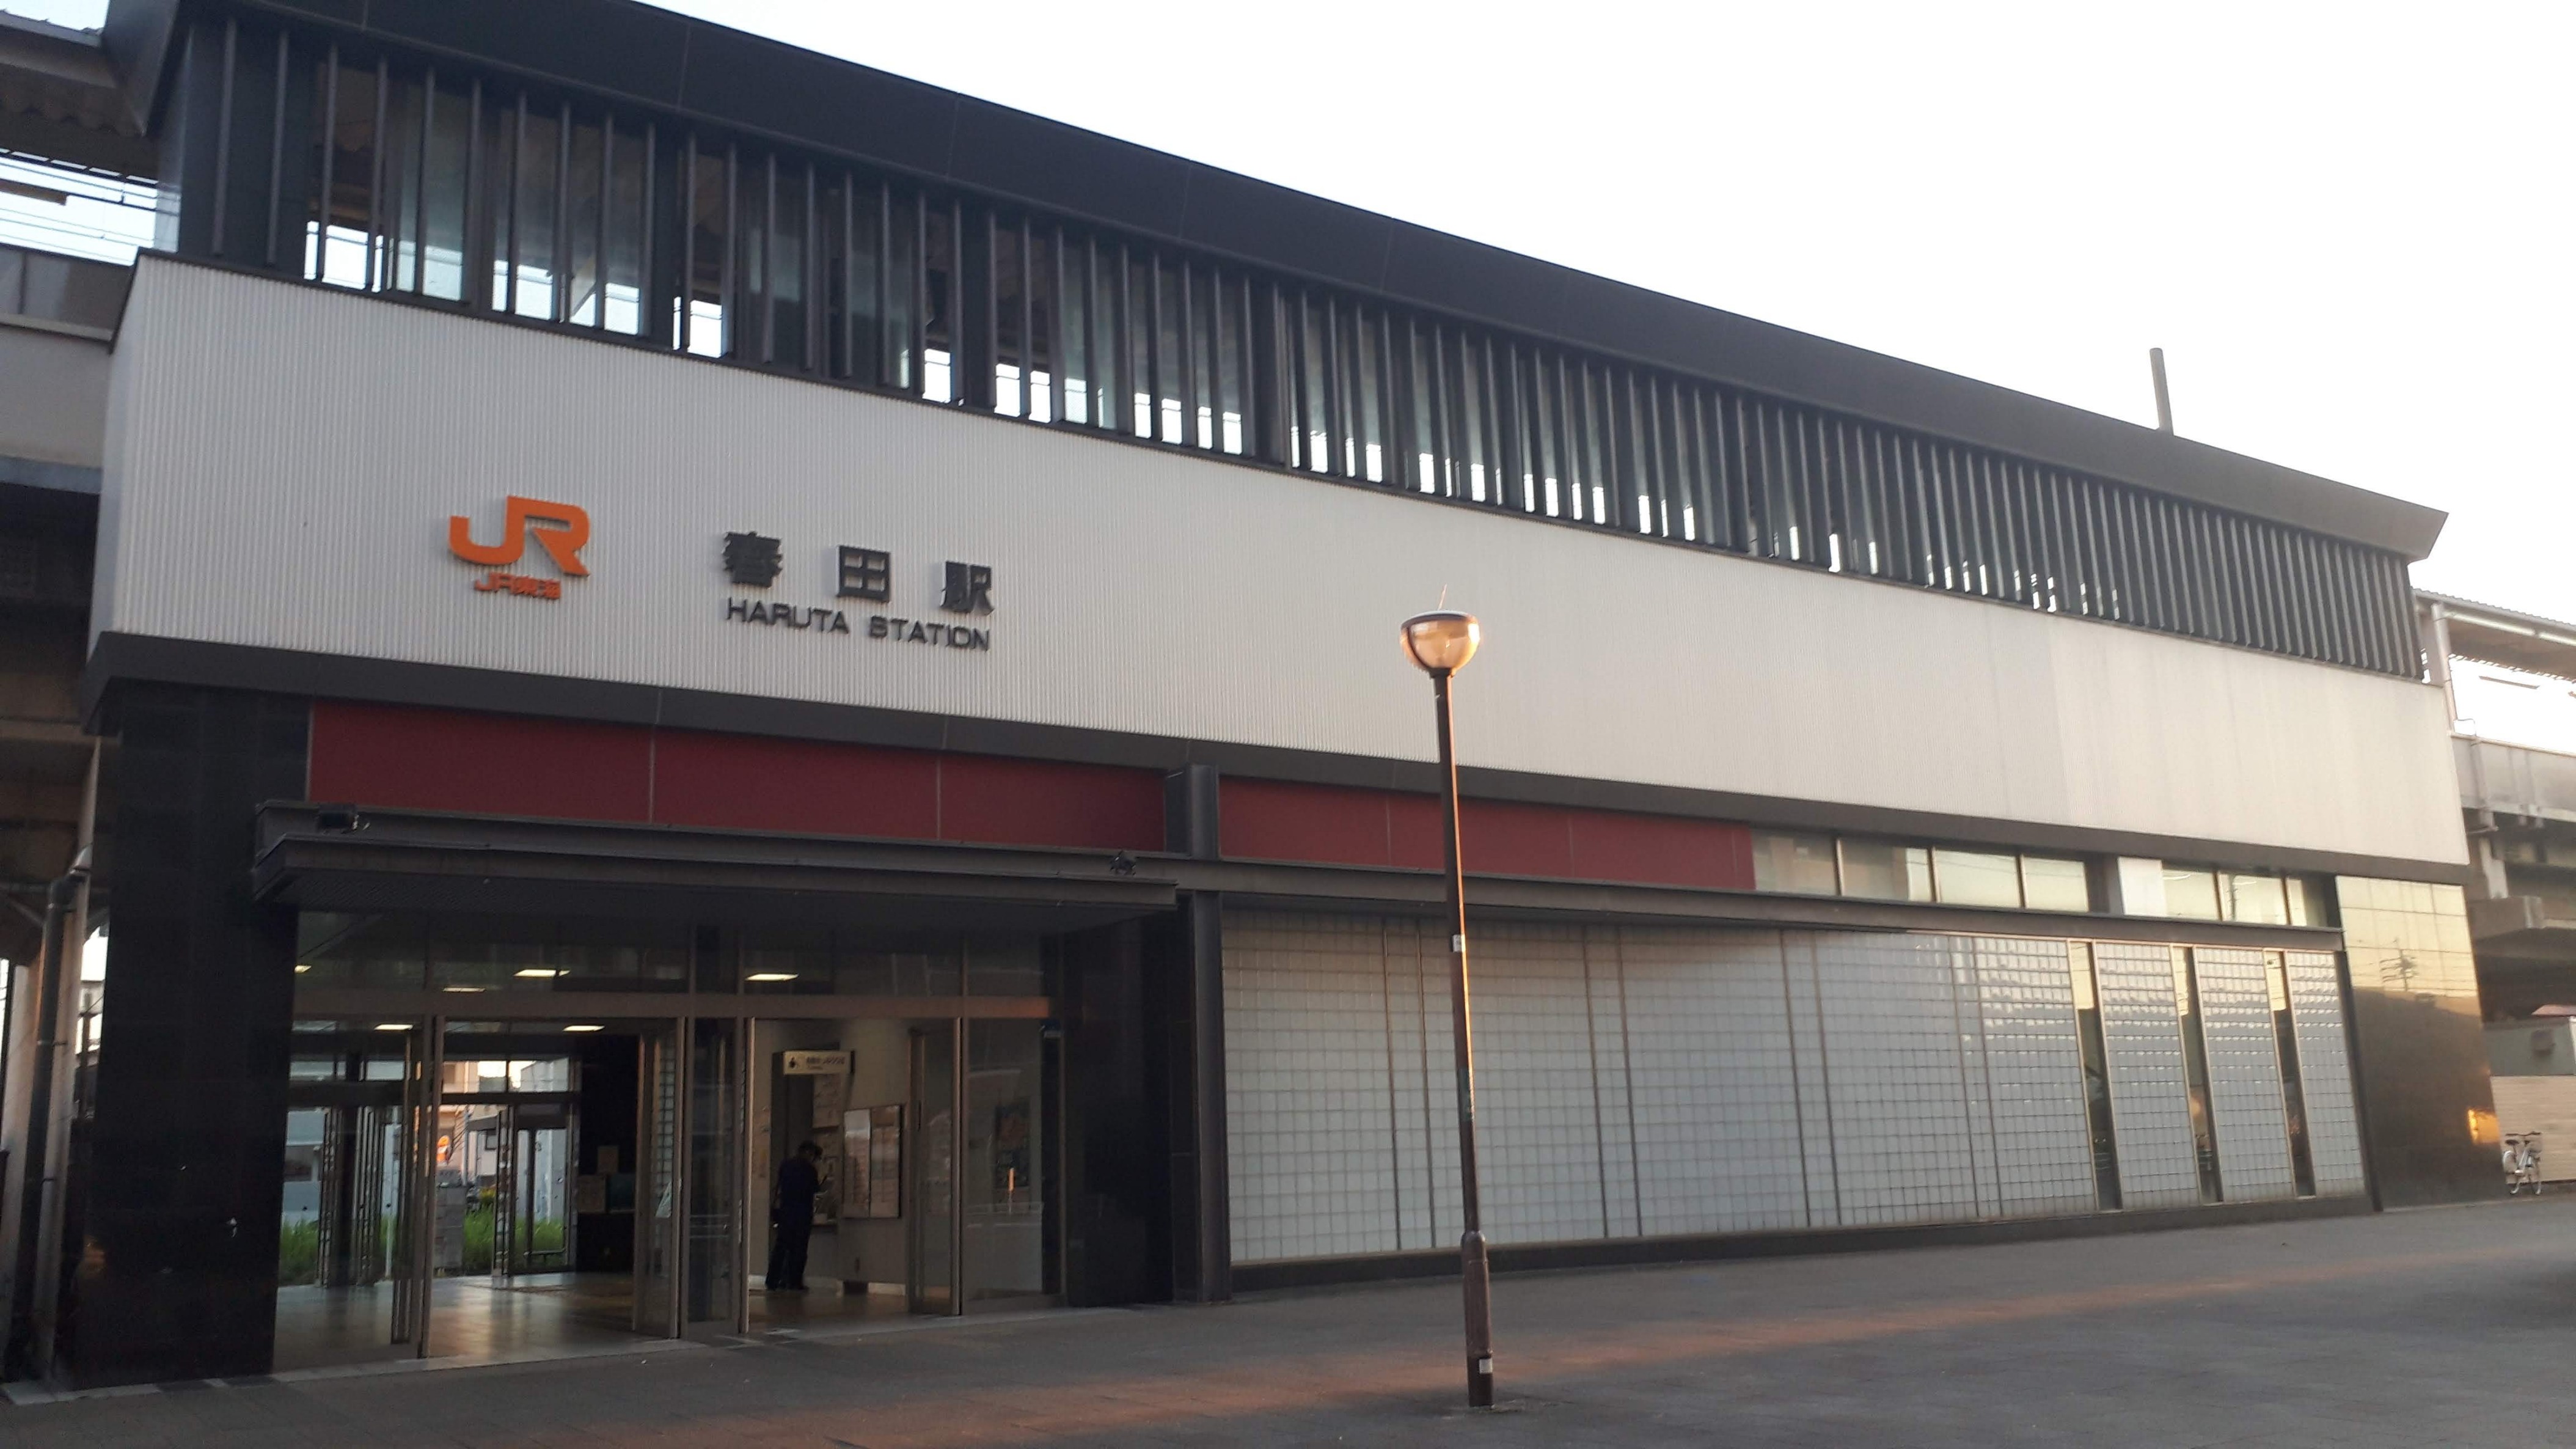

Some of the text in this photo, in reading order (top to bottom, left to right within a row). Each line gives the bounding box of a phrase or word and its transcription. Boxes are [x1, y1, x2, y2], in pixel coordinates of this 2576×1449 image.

[449, 495, 590, 576] JR
[474, 571, 562, 600] JR東海
[723, 531, 995, 615] 春田駅
[726, 597, 990, 651] HARUTA STATION
